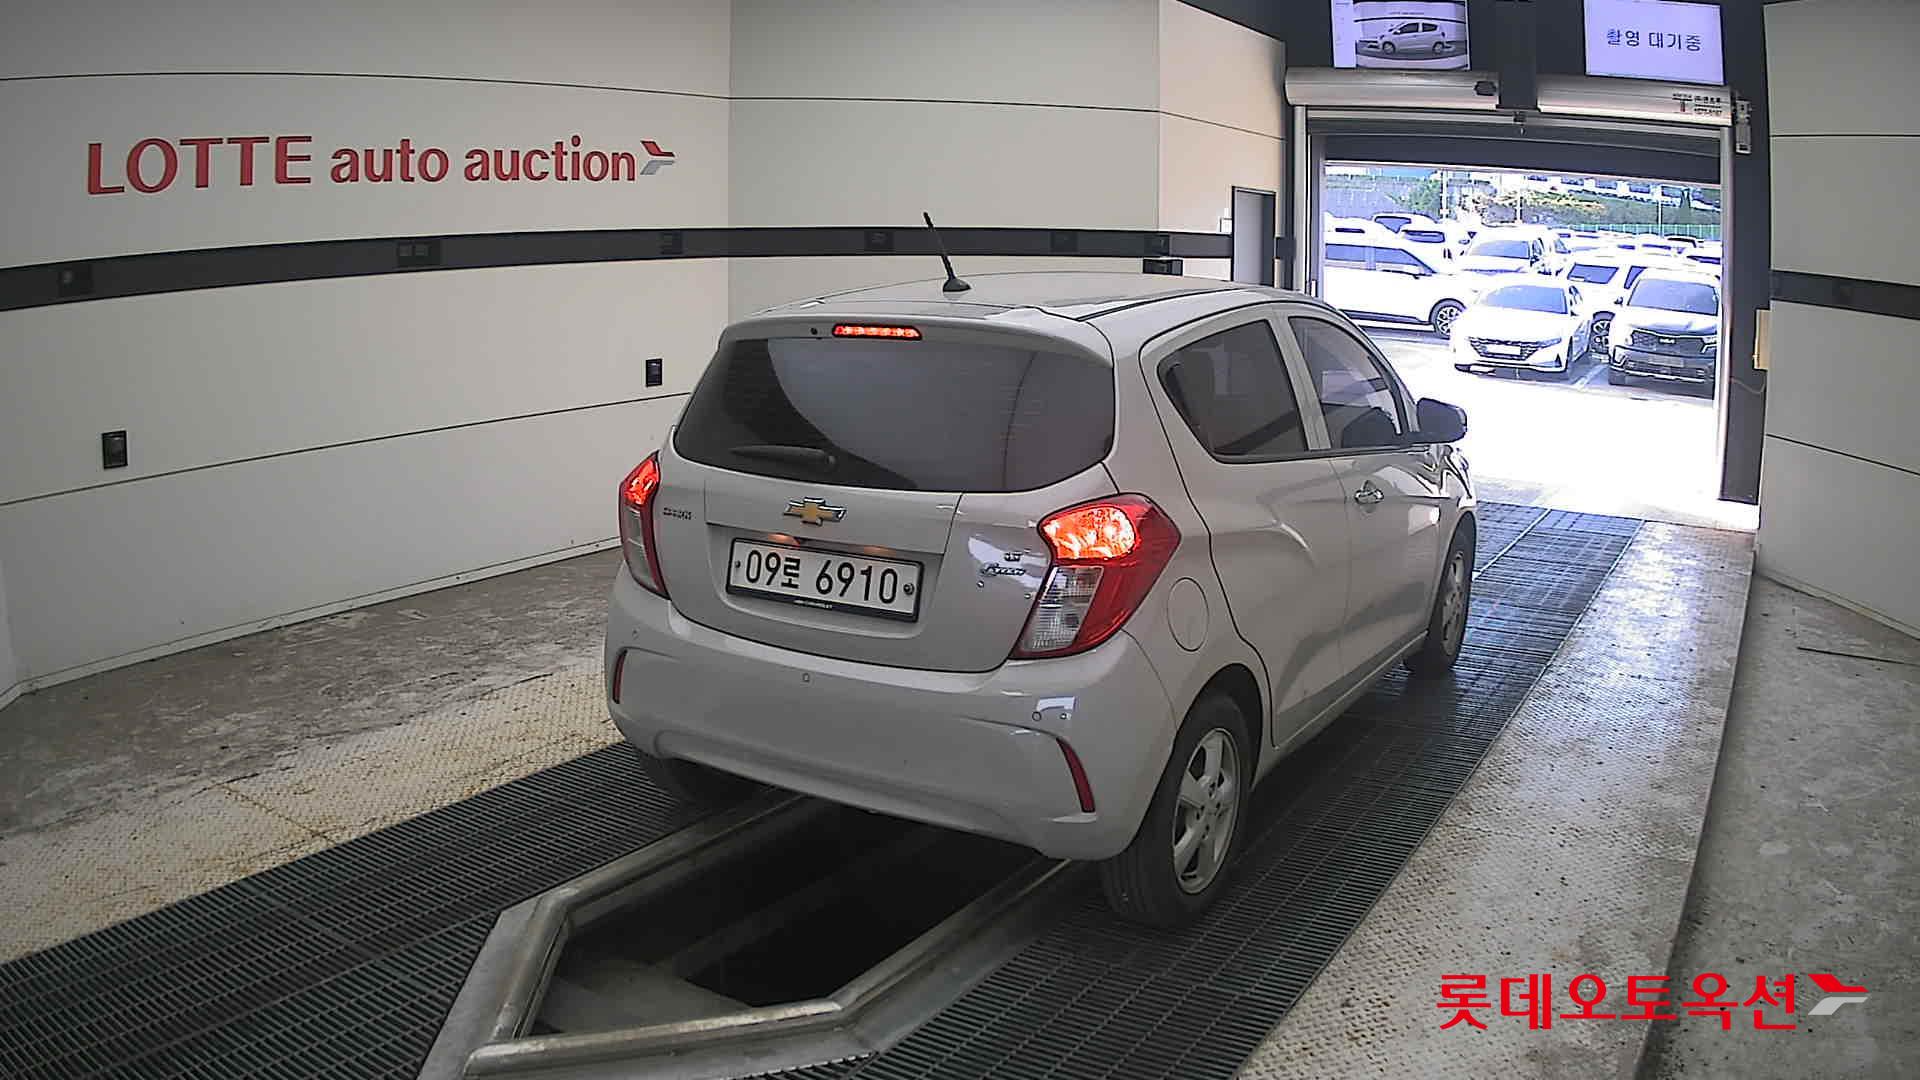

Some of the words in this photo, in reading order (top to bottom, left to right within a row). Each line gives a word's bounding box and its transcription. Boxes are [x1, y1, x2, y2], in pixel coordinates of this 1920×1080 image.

[1606, 28, 1640, 48] 촬영
[1648, 31, 1702, 52] 대기중
[87, 135, 311, 194] LOTTE
[330, 138, 450, 184] auto
[464, 135, 637, 183] auction
[746, 549, 801, 590] 09로
[815, 559, 899, 604] 6910
